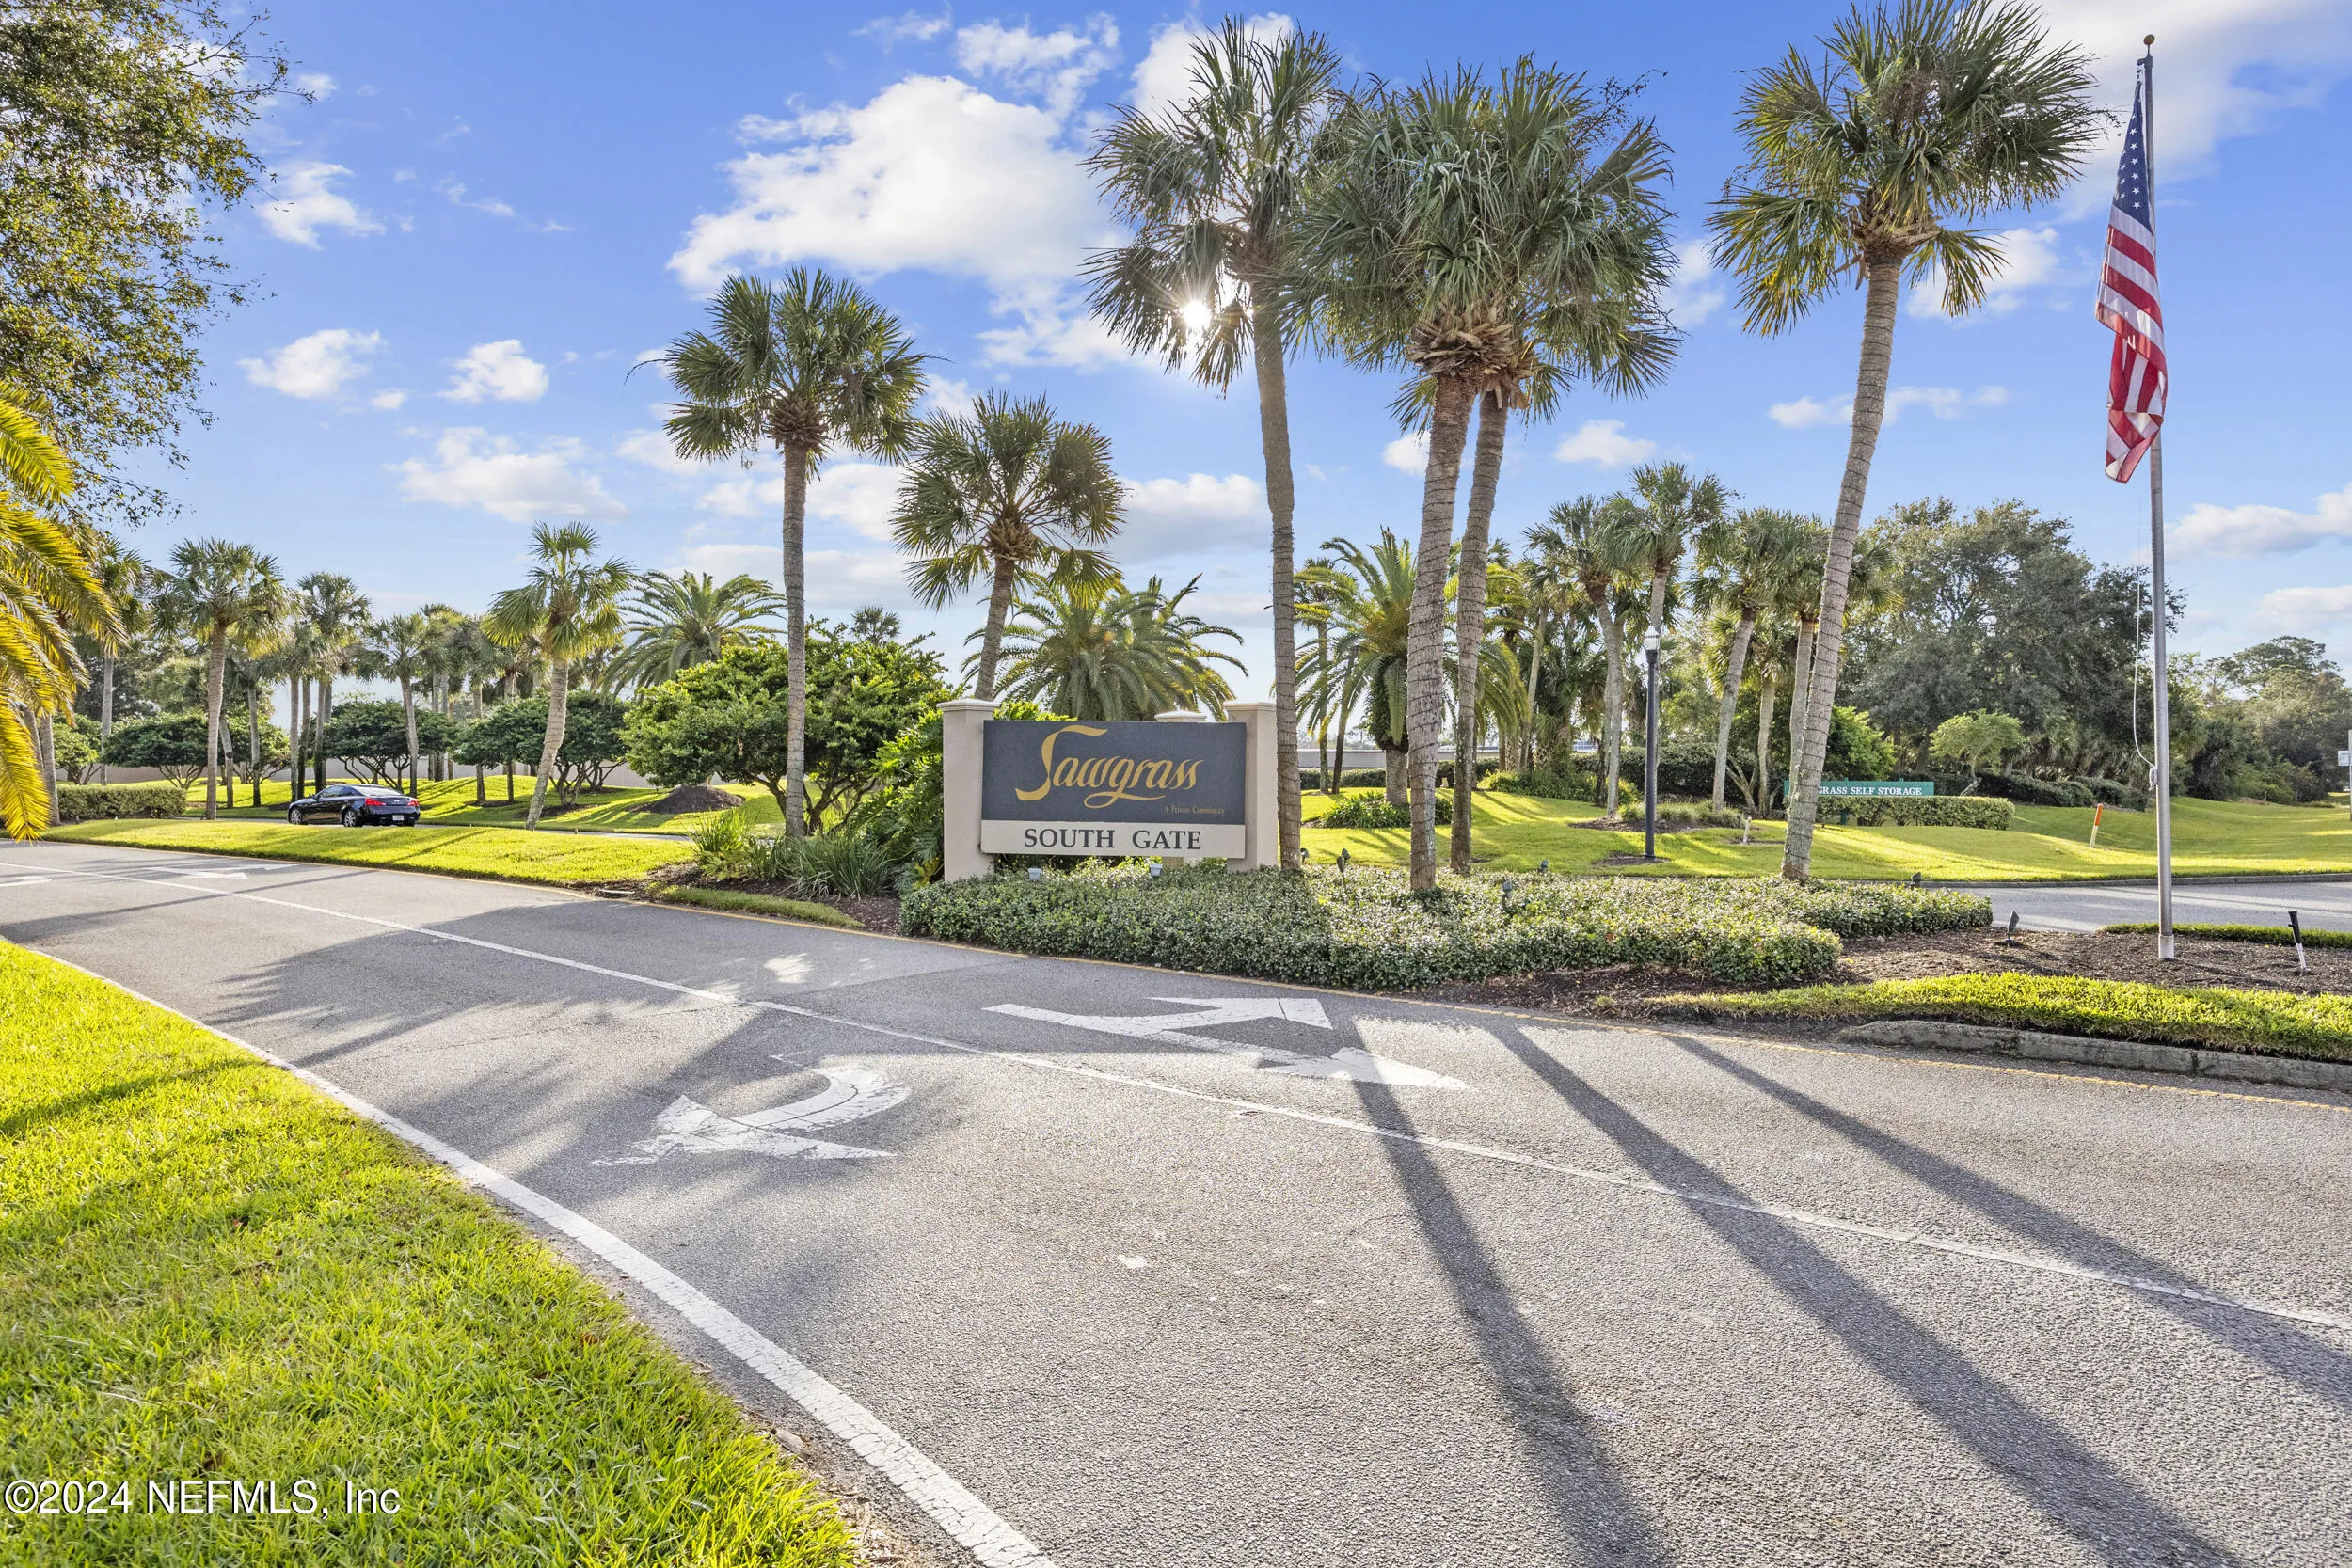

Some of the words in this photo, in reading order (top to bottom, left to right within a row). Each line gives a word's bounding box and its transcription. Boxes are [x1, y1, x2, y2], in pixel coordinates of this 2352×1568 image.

[1015, 724, 1205, 809] Sawgrass
[1818, 786, 1848, 795] GRASS
[1877, 787, 1922, 796] STORAGE
[1024, 828, 1116, 849] SOUTH
[1132, 831, 1202, 850] GATE
